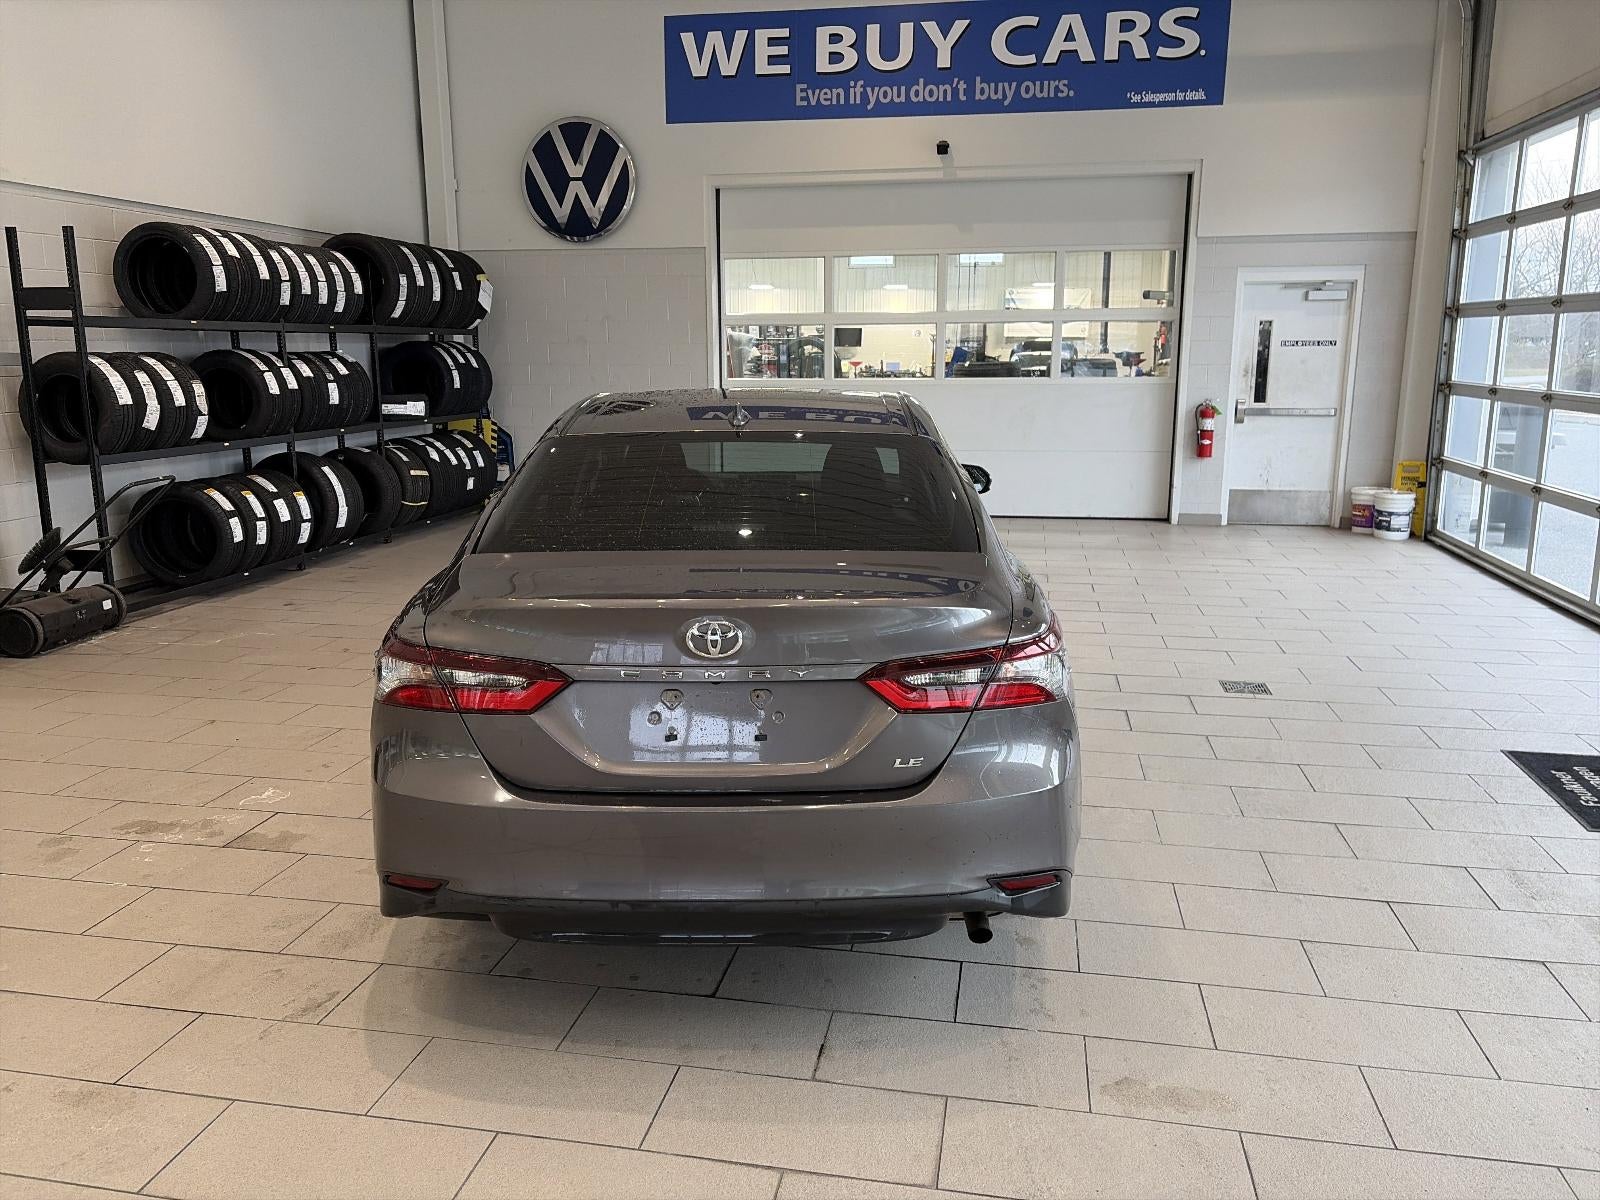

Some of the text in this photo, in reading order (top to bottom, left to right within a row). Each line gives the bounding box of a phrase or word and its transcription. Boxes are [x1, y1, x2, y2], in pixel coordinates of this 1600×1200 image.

[679, 6, 1206, 79] WE BUY CARS.
[795, 76, 1075, 110] Even if you don't buy ours.
[1141, 90, 1176, 104] Salesperson
[1176, 89, 1185, 101] for
[1185, 88, 1207, 101] details.
[620, 668, 815, 680] CAMRY
[893, 757, 924, 768] LE
